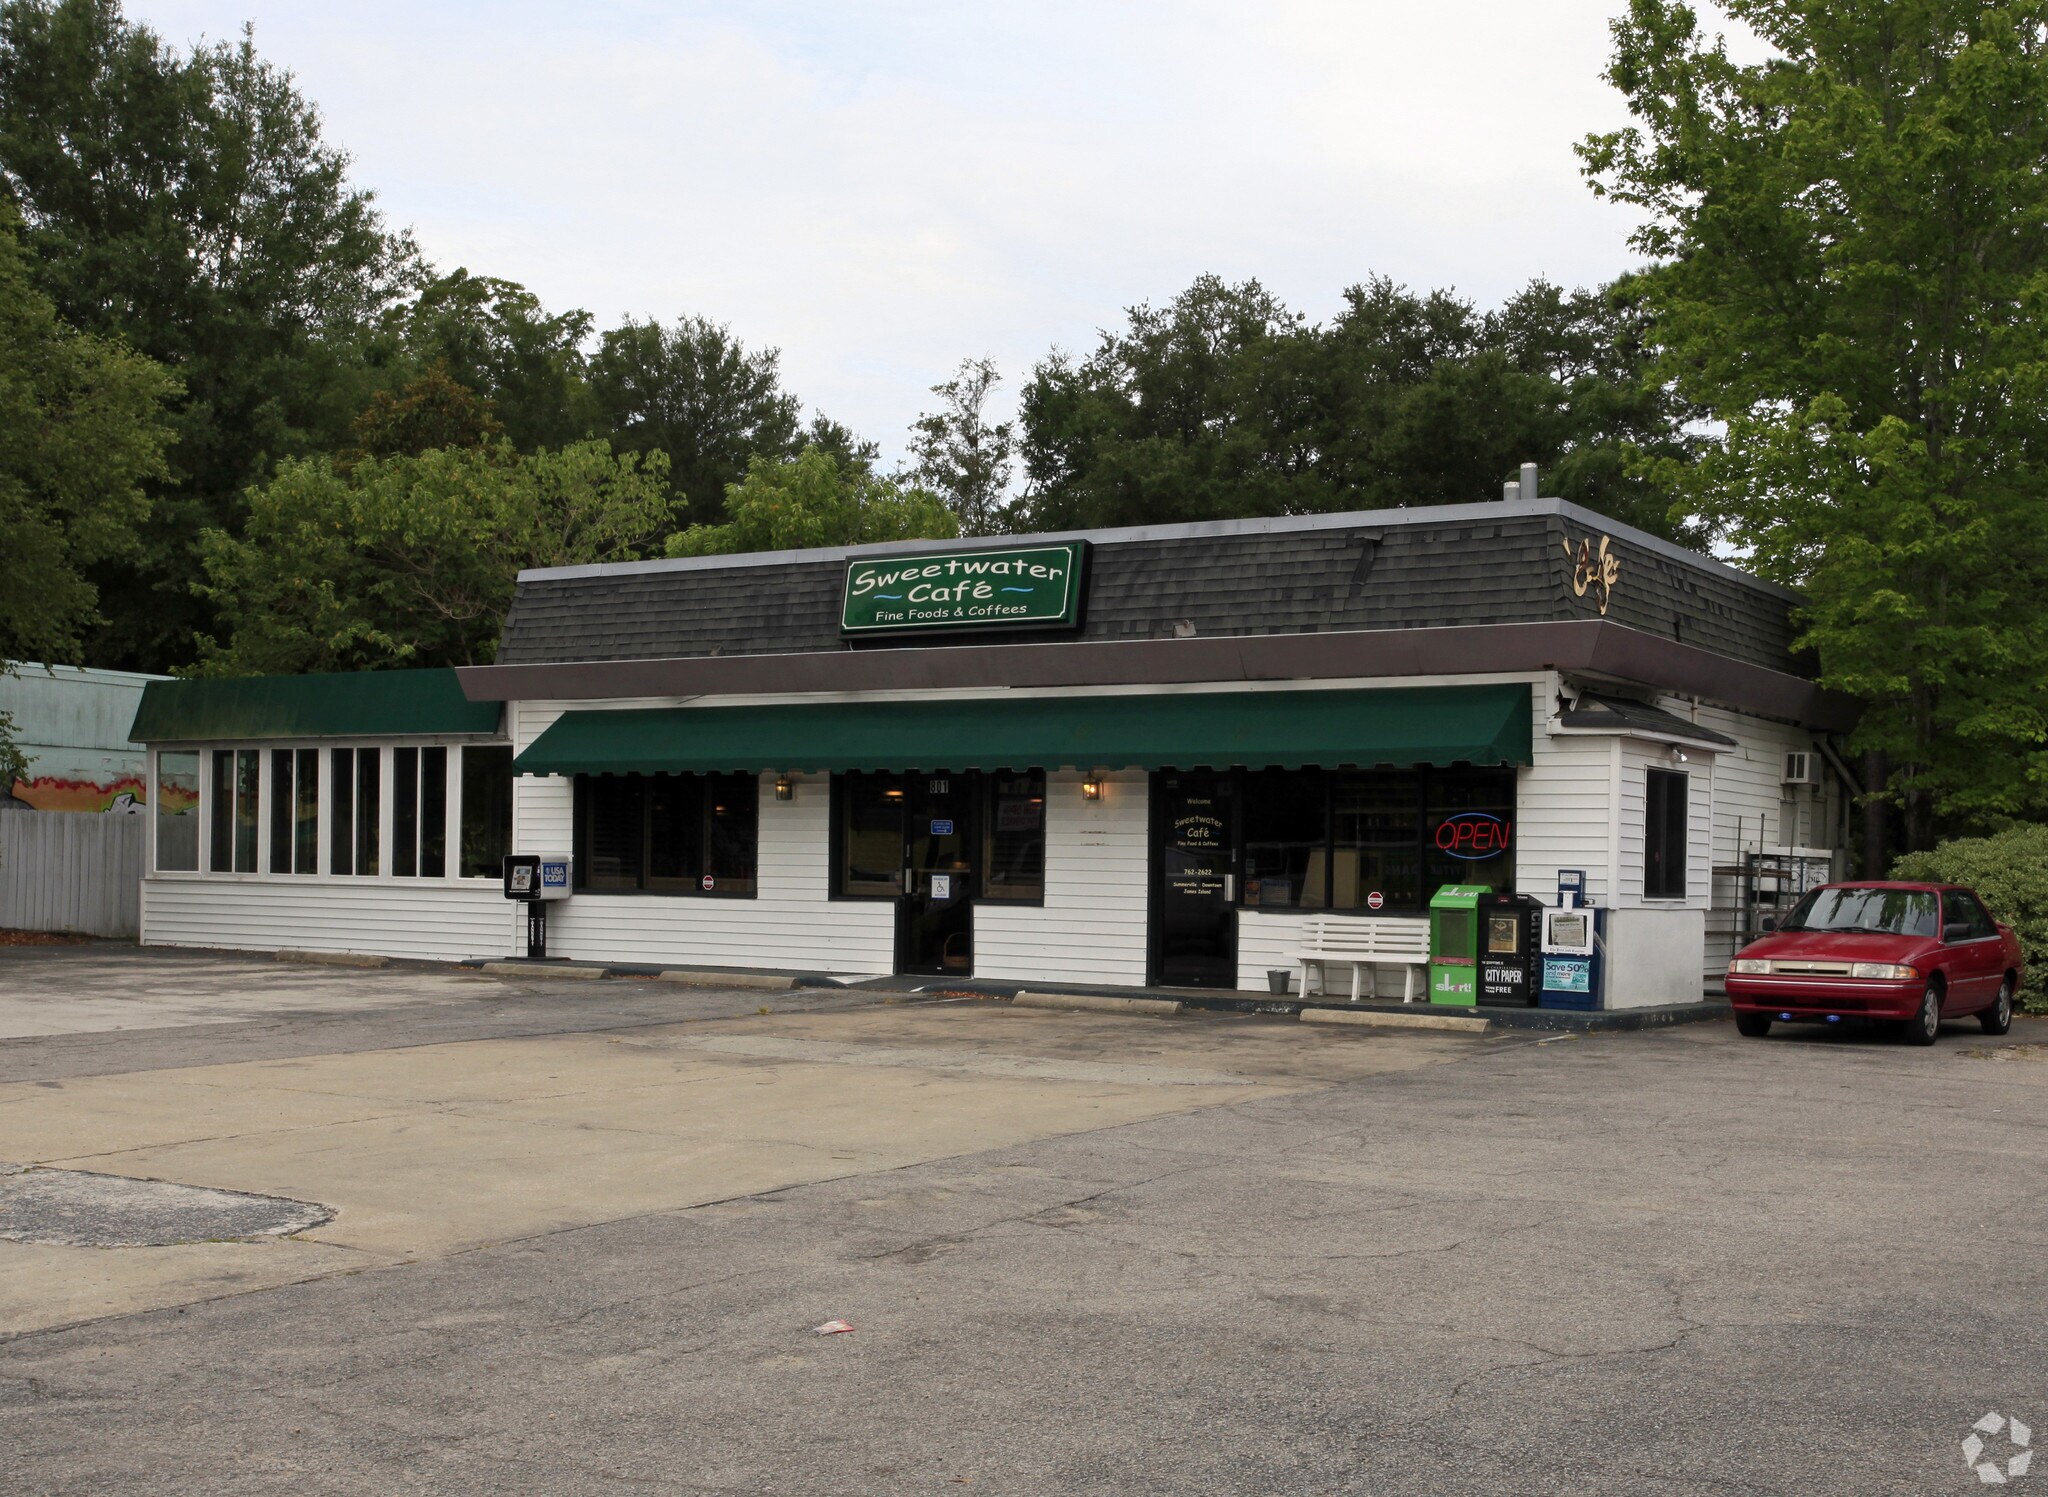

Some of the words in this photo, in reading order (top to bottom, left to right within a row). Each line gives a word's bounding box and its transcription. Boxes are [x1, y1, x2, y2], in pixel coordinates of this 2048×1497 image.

[852, 559, 1063, 596] Sweetwater
[908, 580, 993, 603] Café
[875, 611, 904, 622] Fine
[908, 607, 949, 619] Foods
[953, 606, 964, 617] &
[968, 604, 1027, 616] Coffees
[930, 780, 949, 793] 801
[1175, 816, 1222, 828] Sweetwater
[1188, 828, 1210, 838] Café
[1435, 822, 1511, 849] OPEN
[545, 874, 565, 882] TODAY
[1546, 962, 1566, 971] Save
[1567, 964, 1589, 973] 50%
[1486, 970, 1500, 982] CITY
[1502, 970, 1522, 984] PAPER
